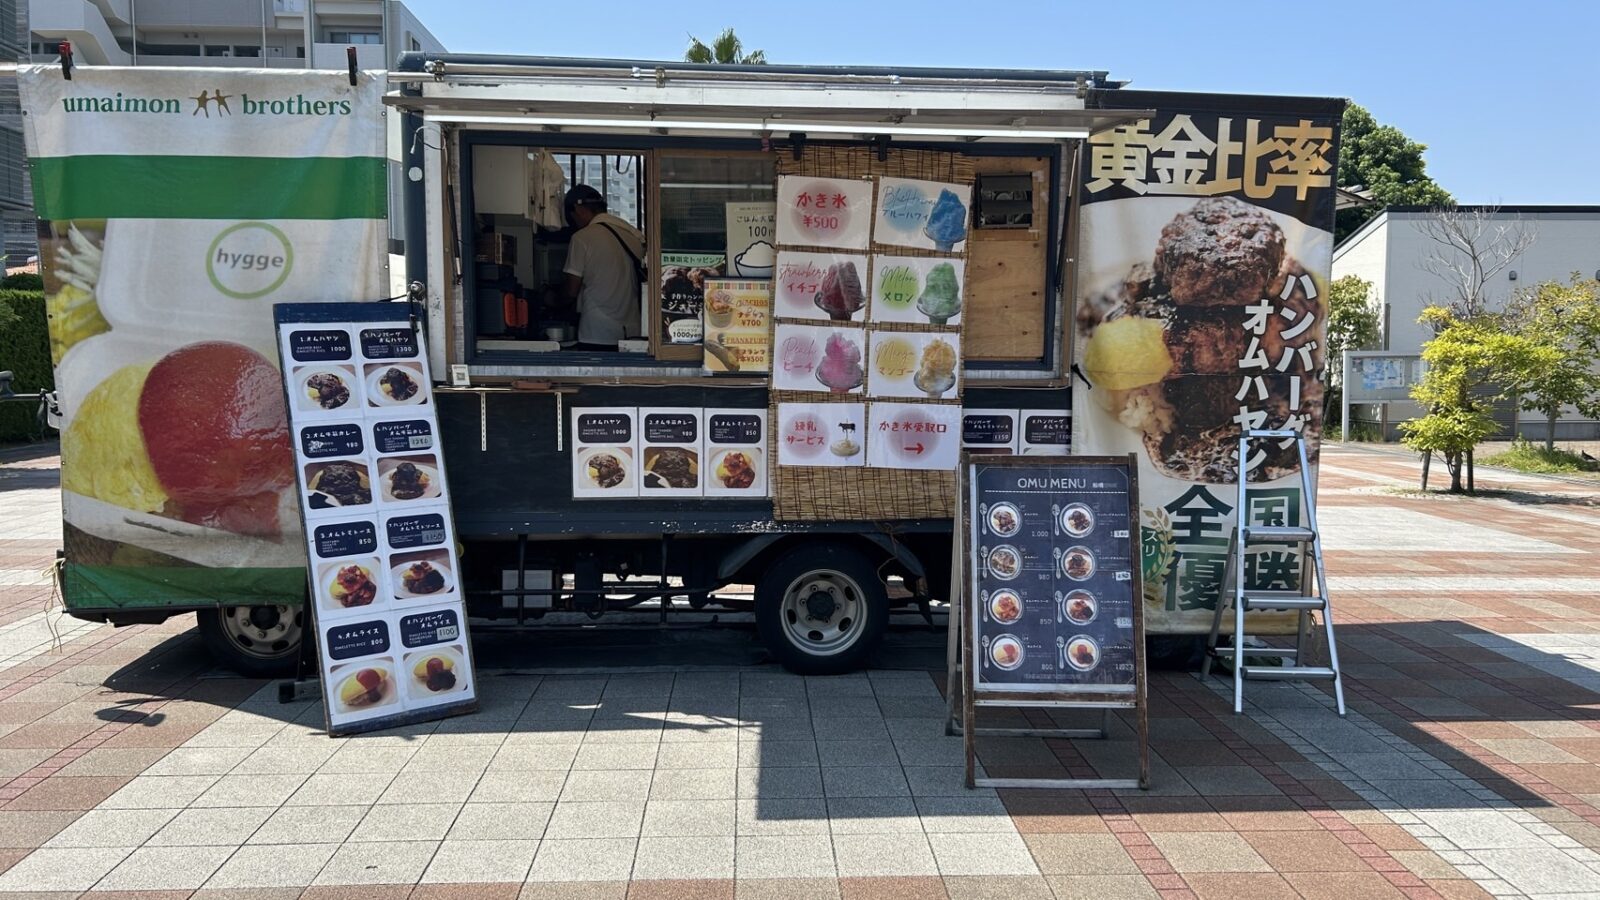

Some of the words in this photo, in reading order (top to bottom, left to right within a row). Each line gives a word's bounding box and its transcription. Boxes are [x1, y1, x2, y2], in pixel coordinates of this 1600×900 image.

[62, 93, 181, 114] umaimon
[241, 94, 352, 115] brothers
[1085, 113, 1333, 201] 黄金比率
[796, 191, 848, 209] かき氷
[803, 215, 839, 230] ¥500
[216, 248, 284, 271] hygge
[787, 282, 819, 293] イチゴ
[883, 291, 914, 303] メロン
[783, 362, 814, 372] ピーチ
[1275, 274, 1318, 450] ハンバーグ
[879, 367, 914, 376] マンゴー
[879, 420, 947, 433] かき氷受取口
[786, 435, 825, 446] サービス
[1017, 478, 1048, 489] OMU
[1050, 478, 1086, 489] MENU
[1164, 485, 1300, 548] 全国
